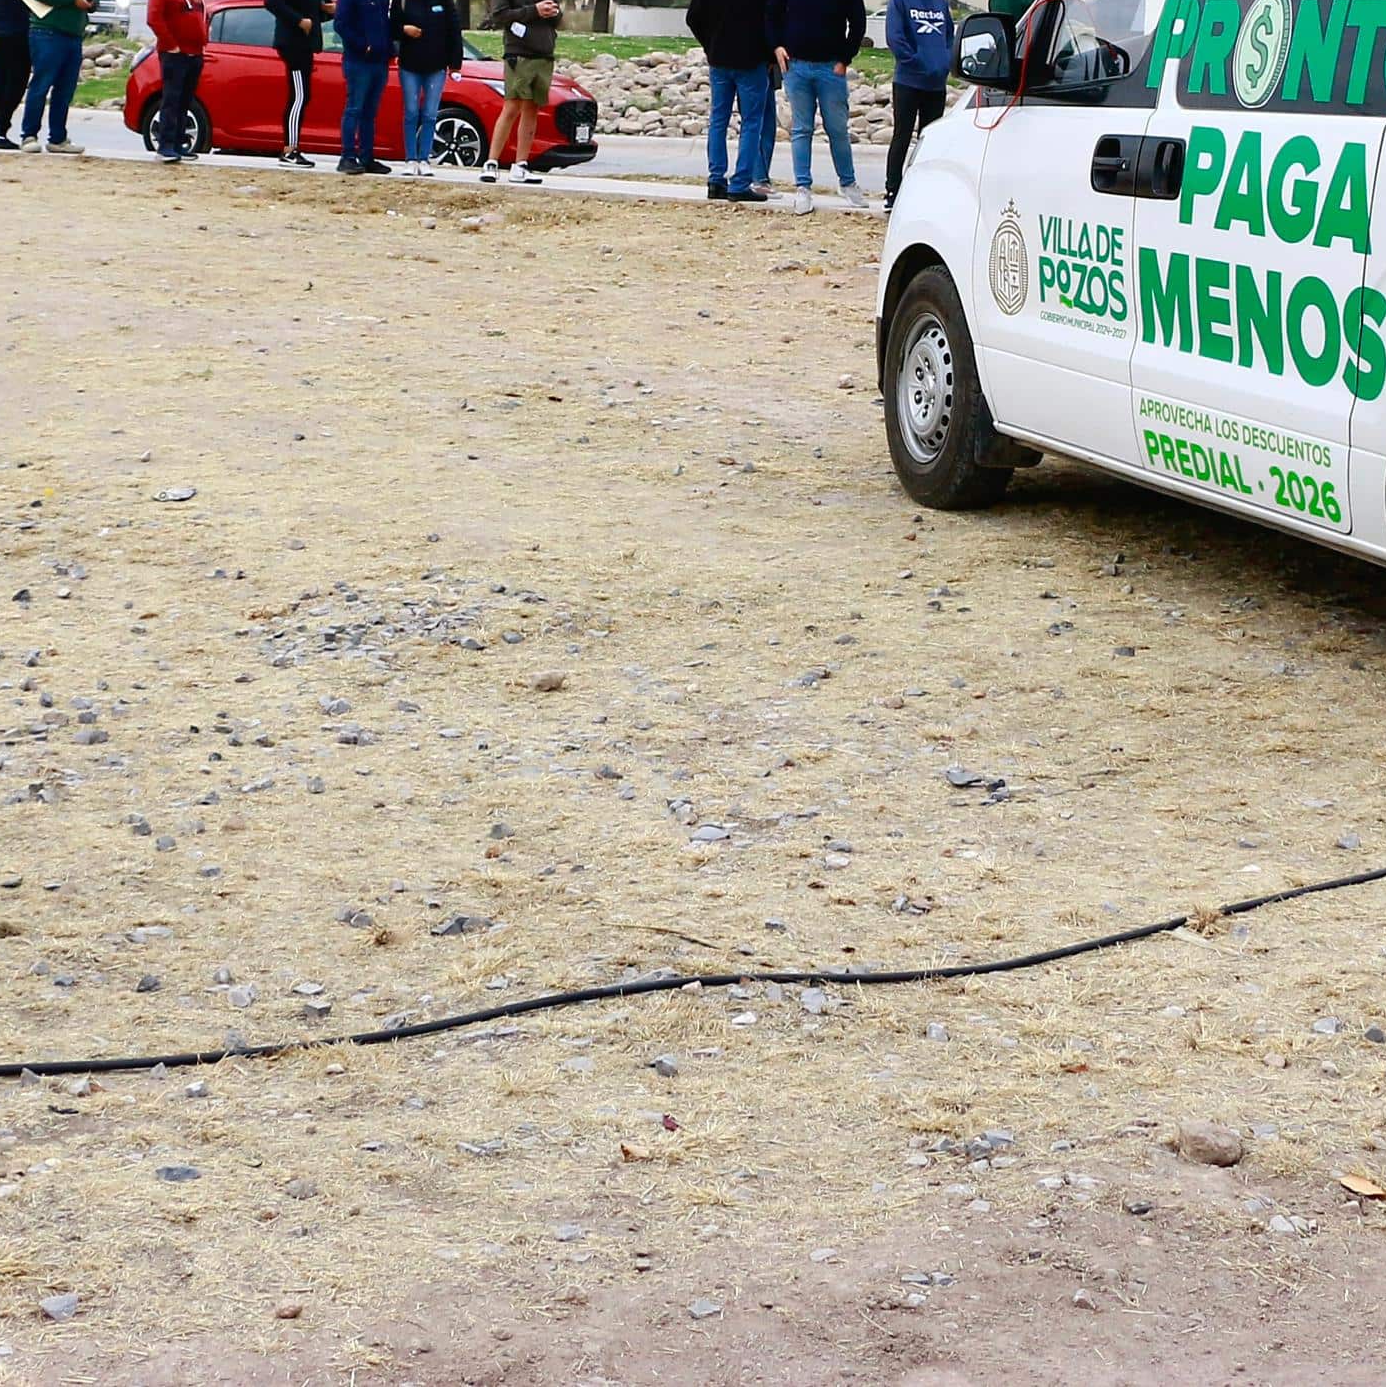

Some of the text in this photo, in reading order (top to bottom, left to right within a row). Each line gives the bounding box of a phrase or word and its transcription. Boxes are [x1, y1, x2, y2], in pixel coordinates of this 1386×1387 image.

[1179, 125, 1372, 255] PAGA
[1039, 214, 1124, 267] VILLA DE
[1139, 398, 1331, 467] APROVECHA LOS DESCUENTOS
[1143, 429, 1253, 495] PREDIAL
[1269, 466, 1342, 523] 2026
